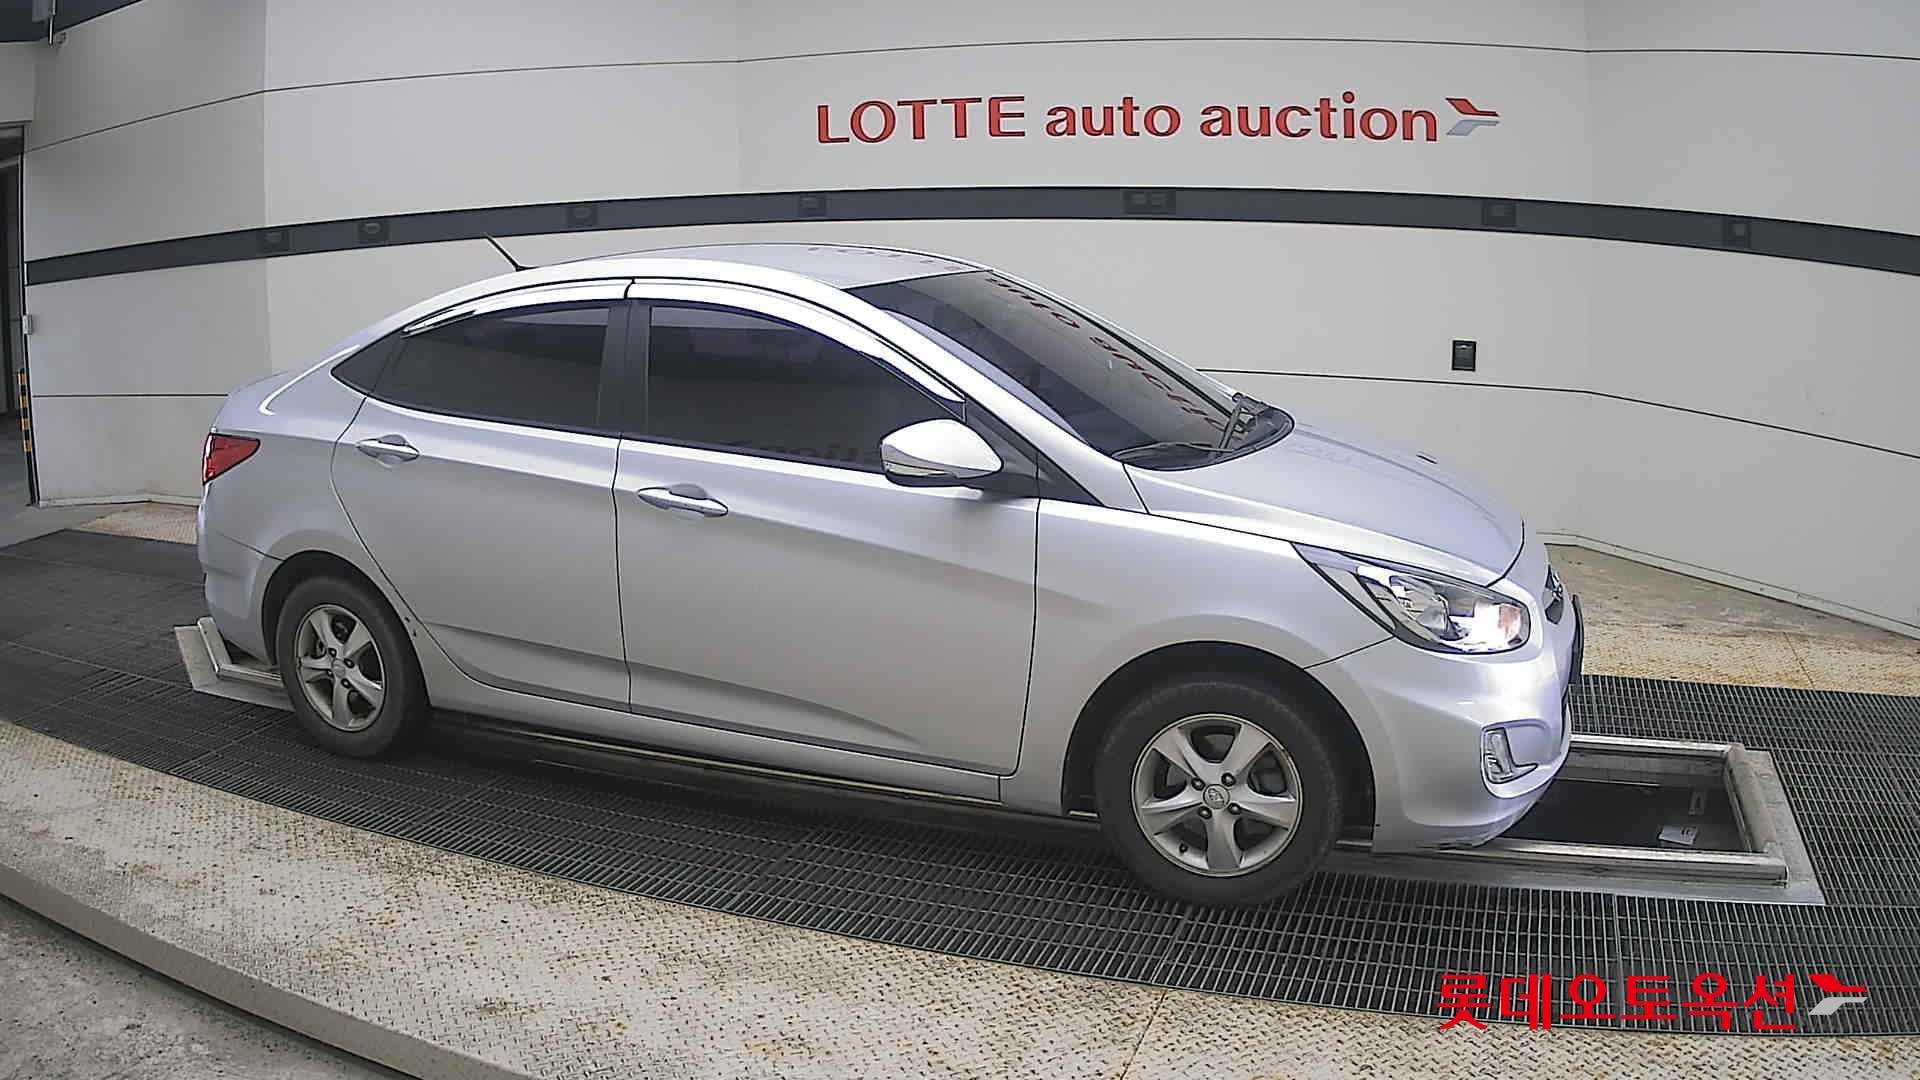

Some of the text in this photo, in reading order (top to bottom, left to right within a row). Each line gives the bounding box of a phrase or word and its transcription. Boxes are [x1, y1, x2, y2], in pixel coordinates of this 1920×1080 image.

[817, 91, 1438, 144] LOTTE auto auction
